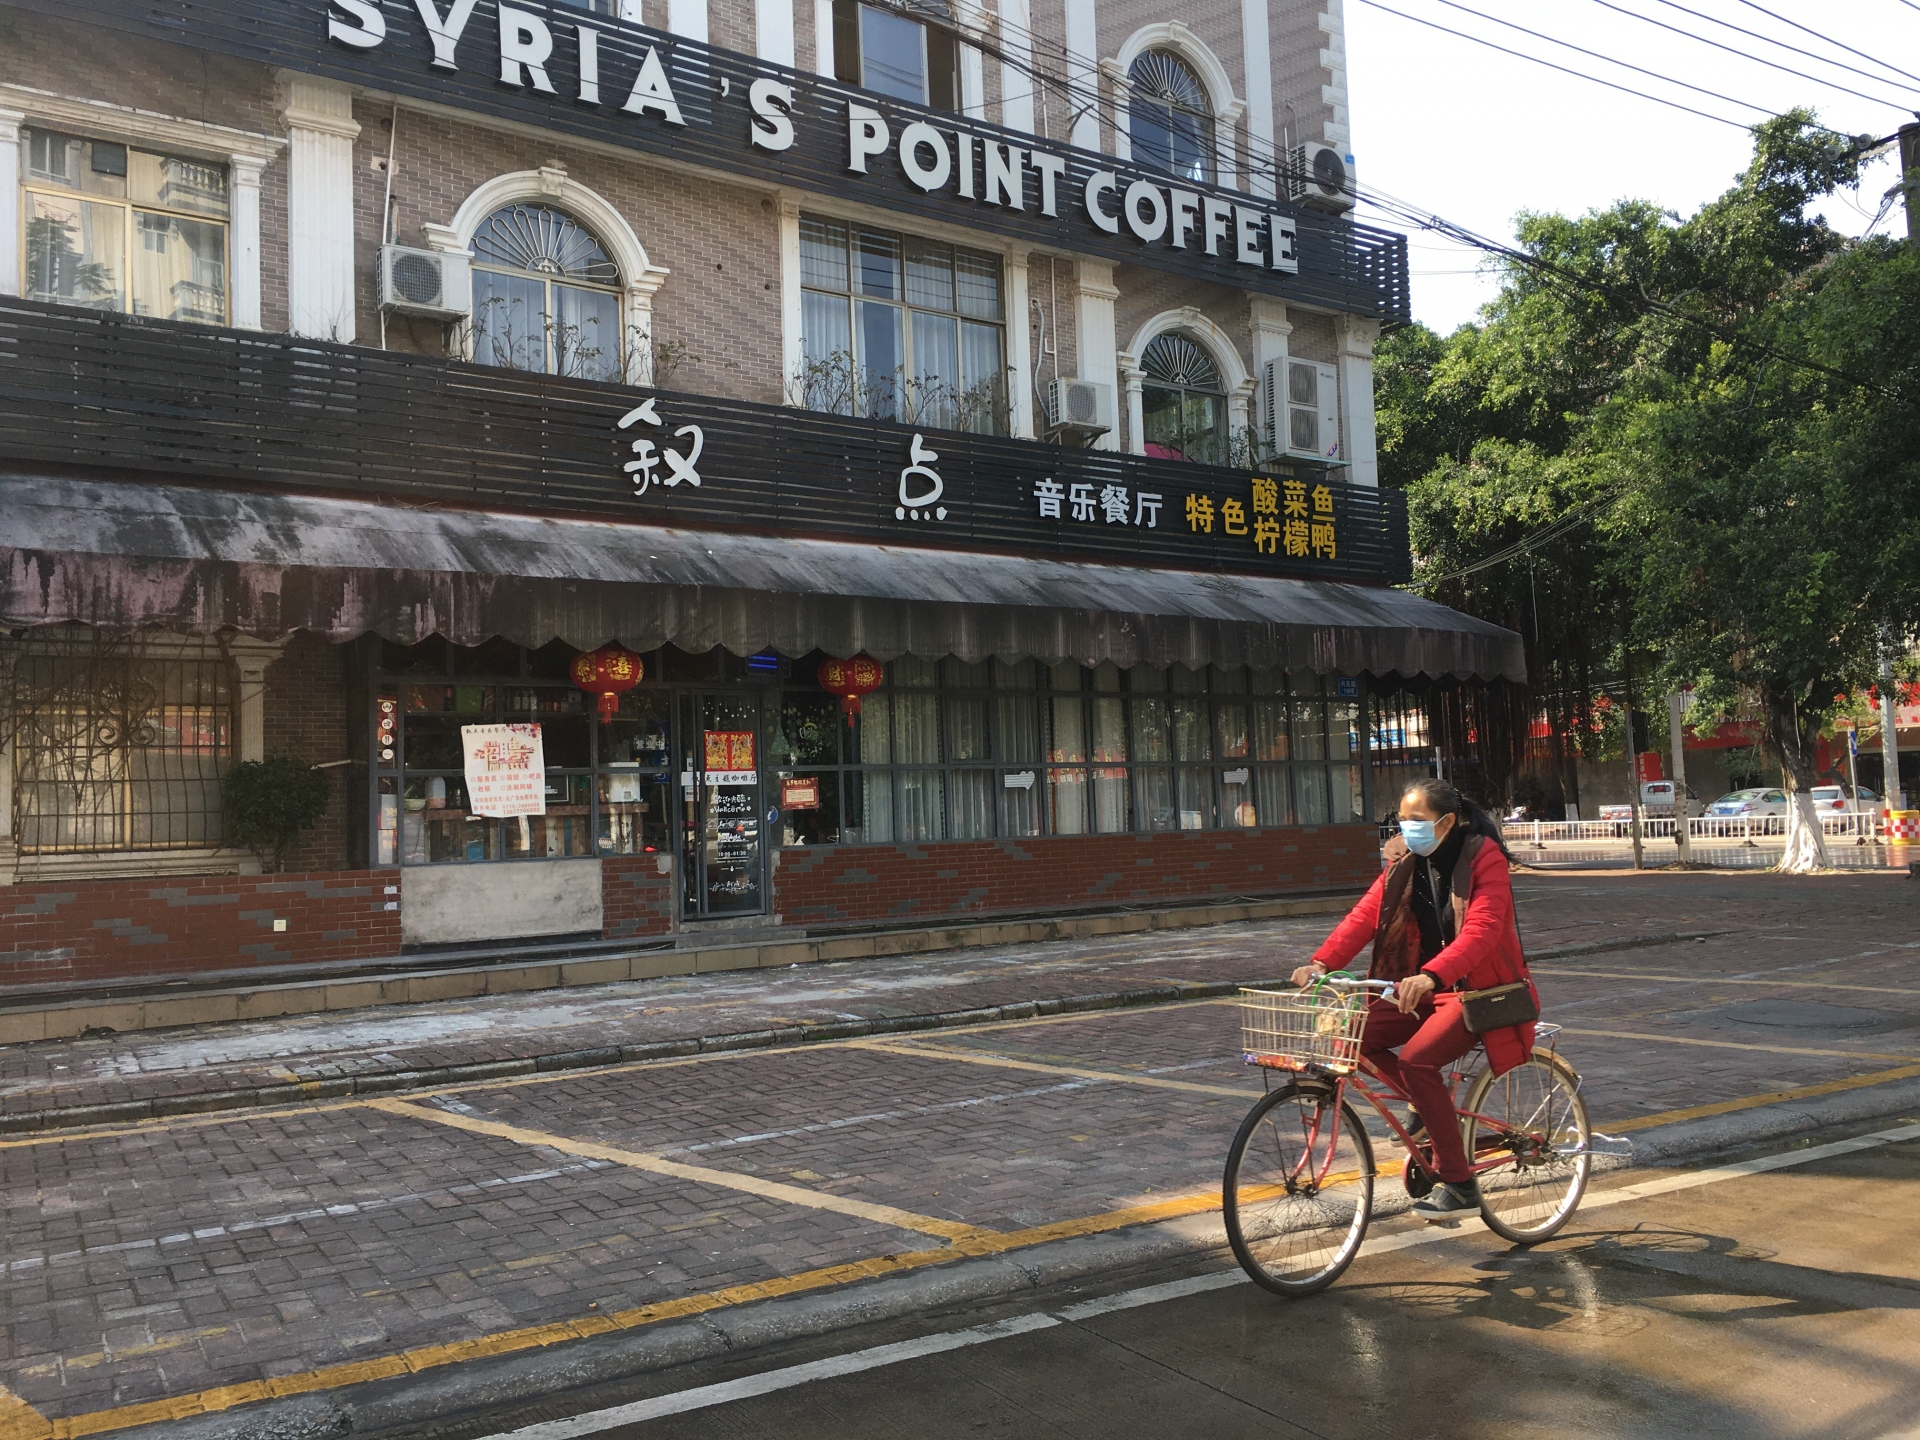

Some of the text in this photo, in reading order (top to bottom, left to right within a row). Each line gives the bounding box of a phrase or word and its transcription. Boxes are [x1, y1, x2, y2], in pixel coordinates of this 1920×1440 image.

[847, 100, 1066, 218] POINT
[1084, 170, 1299, 275] COFFEE
[617, 397, 948, 521] 叙 点
[1033, 477, 1163, 528] 音乐餐厅
[1185, 494, 1248, 535] 特色
[1251, 477, 1337, 522] 酸菜鱼
[1253, 517, 1337, 560] 柠檬鸭
[635, 740, 666, 750] 营业中
